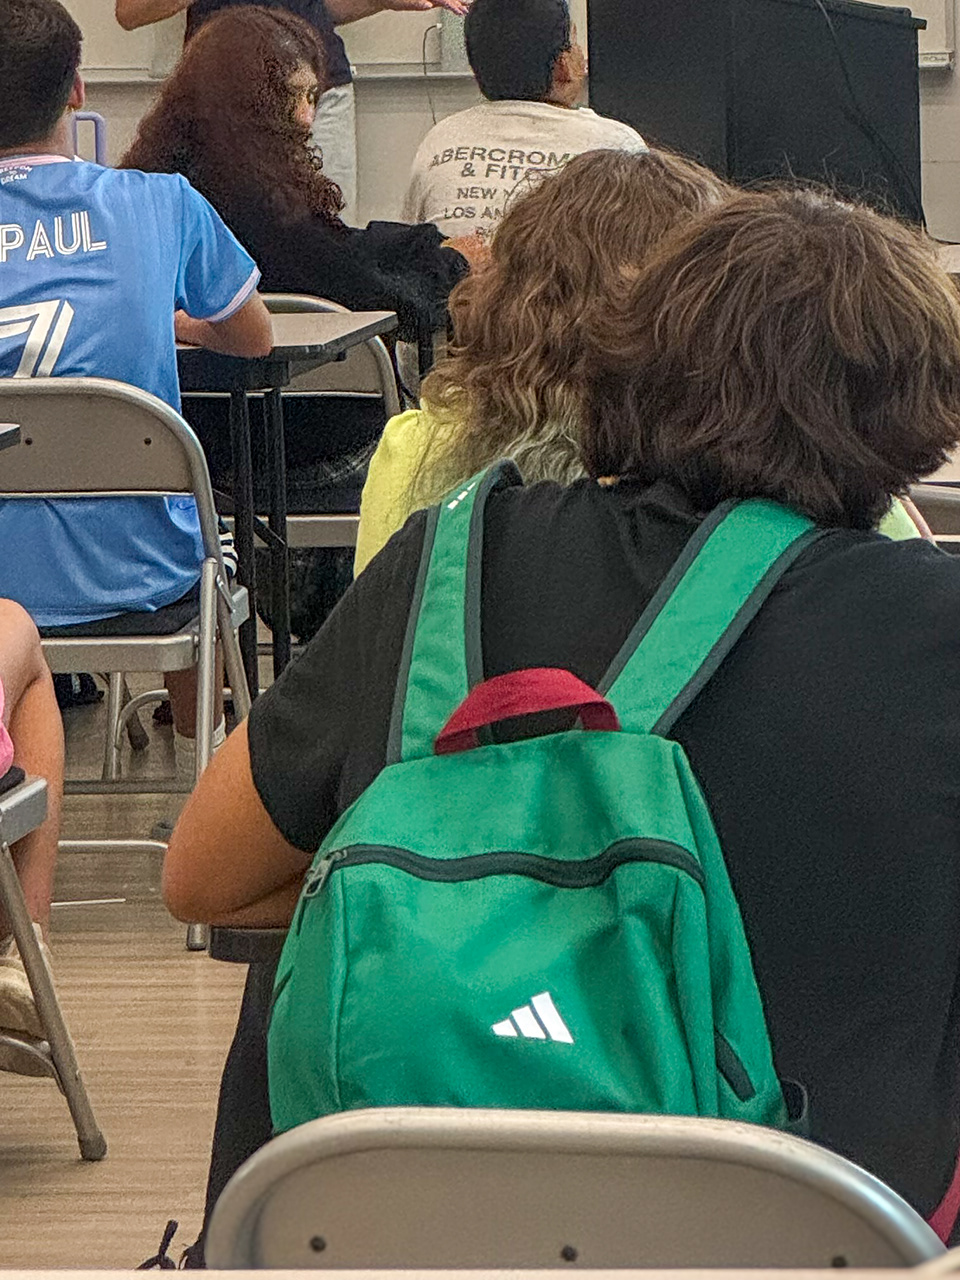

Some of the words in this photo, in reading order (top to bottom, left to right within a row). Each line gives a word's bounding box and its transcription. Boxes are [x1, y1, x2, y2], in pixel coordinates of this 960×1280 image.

[430, 146, 571, 168] ABERCROM
[461, 162, 477, 178] &
[485, 163, 525, 181] FIT
[457, 186, 497, 200] NEW
[444, 206, 476, 220] LOS
[0, 210, 108, 263] PAUL
